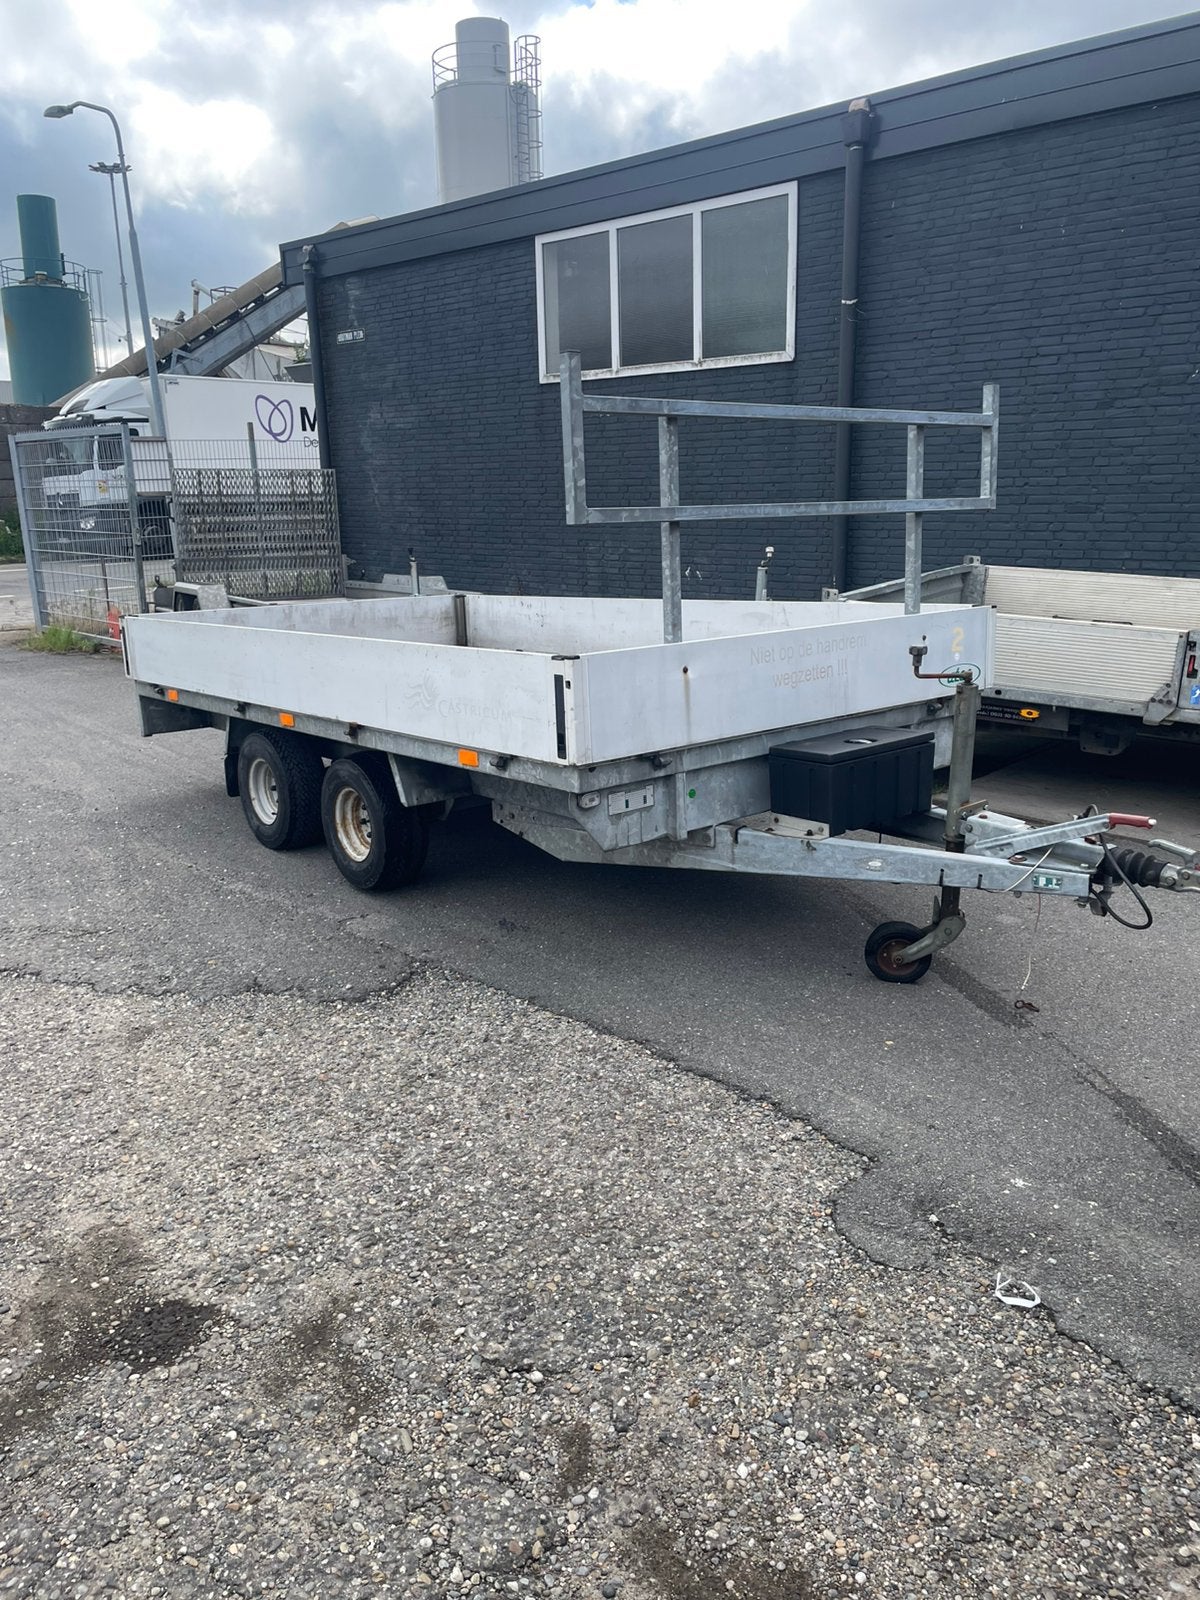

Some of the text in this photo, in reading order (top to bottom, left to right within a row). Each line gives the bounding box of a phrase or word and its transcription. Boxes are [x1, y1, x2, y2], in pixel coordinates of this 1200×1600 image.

[750, 632, 867, 665] Niet op de handrem
[772, 663, 834, 689] wegzetten
